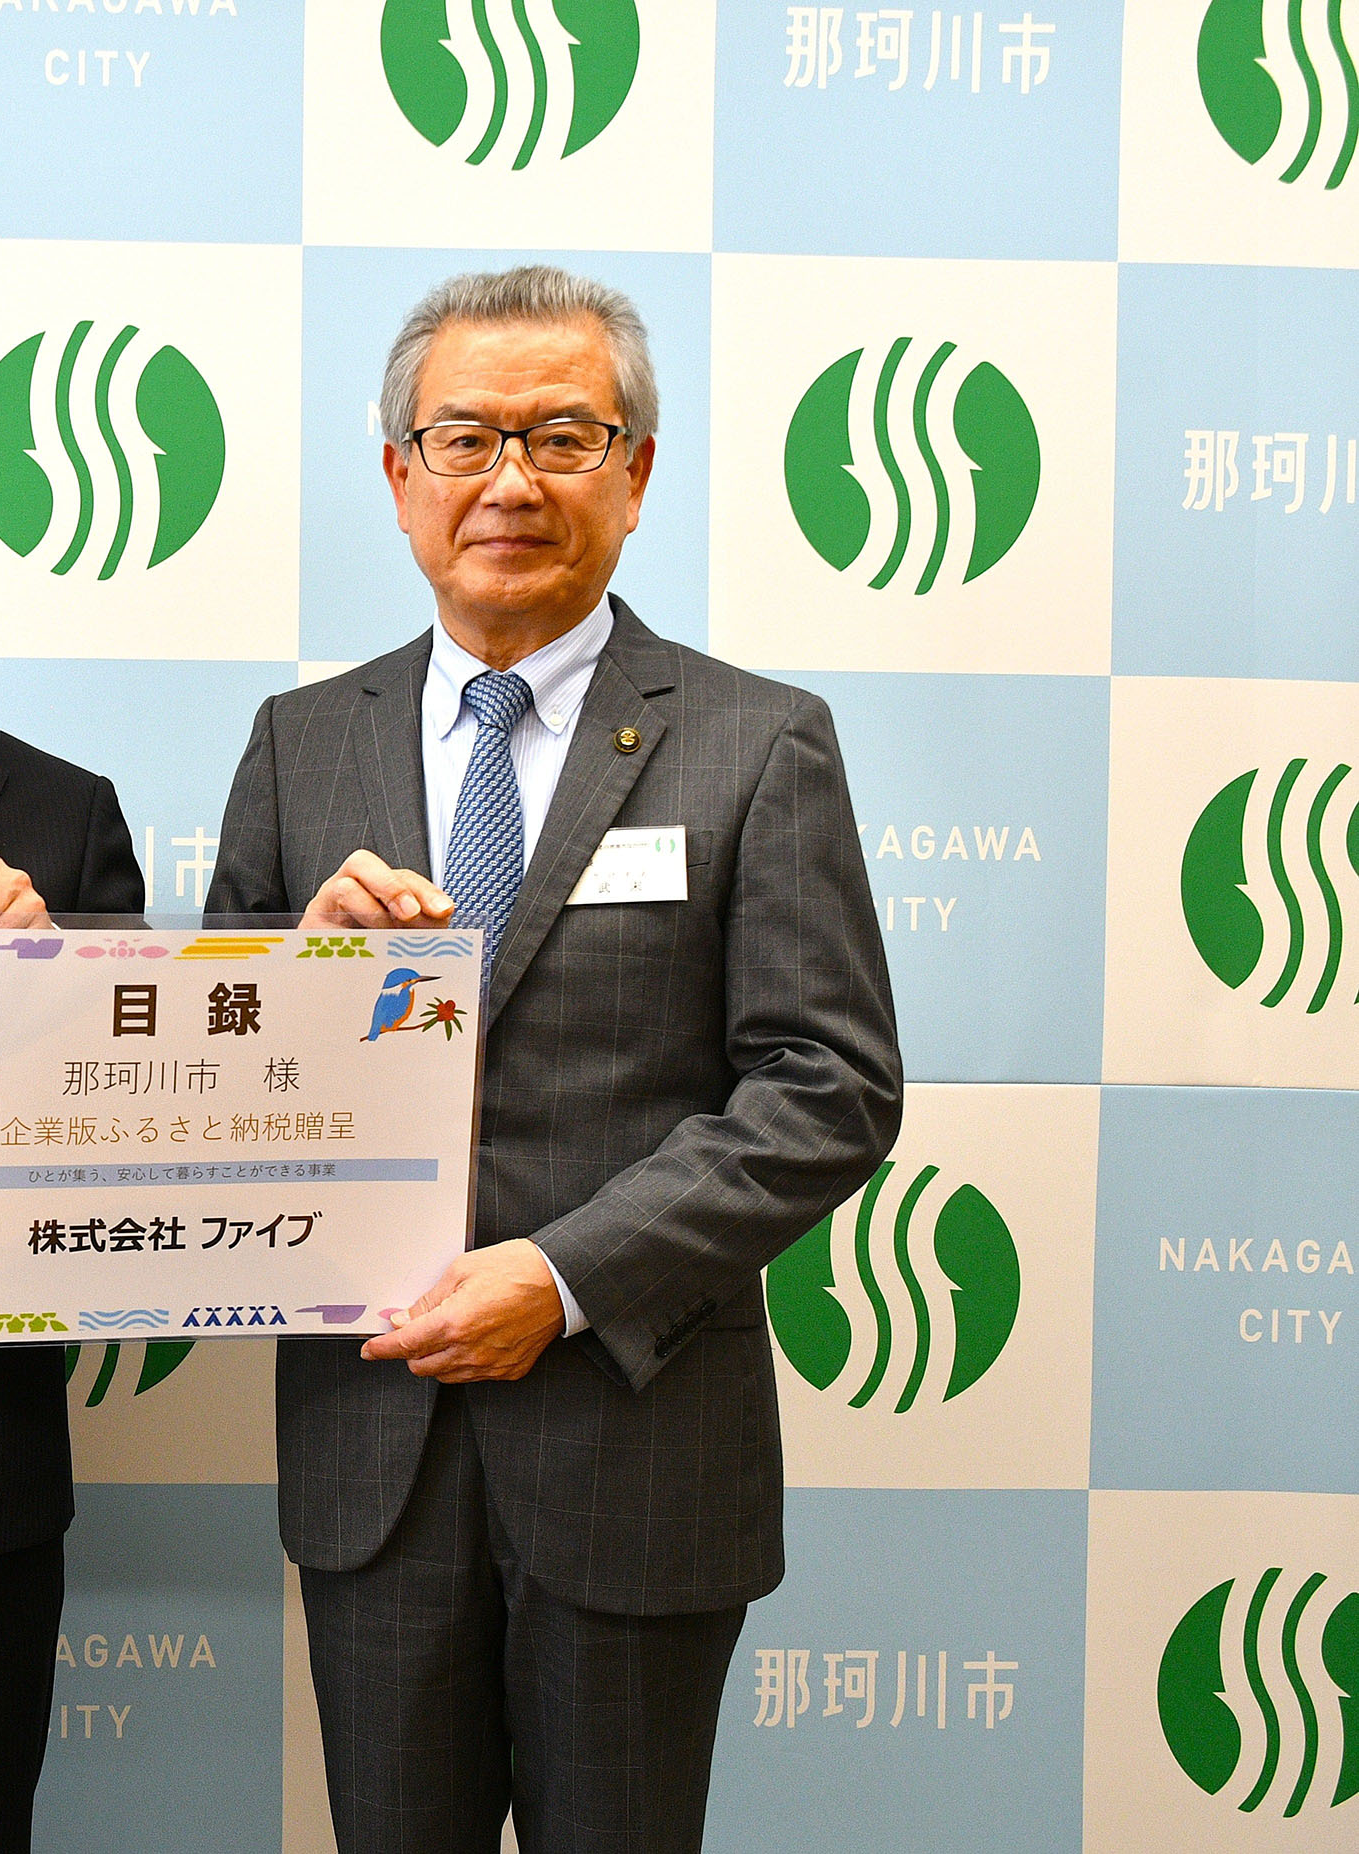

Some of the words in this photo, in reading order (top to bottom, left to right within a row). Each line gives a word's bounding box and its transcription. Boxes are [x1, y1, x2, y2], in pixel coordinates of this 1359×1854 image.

[44, 48, 151, 87] CITY
[784, 6, 1056, 95] 那珂川市
[62, 1059, 221, 1097] 那珂川市
[263, 1056, 300, 1093] 様
[0, 1111, 356, 1146] 企業版ふるさと納税贈呈
[28, 1163, 337, 1183] ひとが集う、安心して暮らすことができる事業
[27, 1216, 186, 1255] 株式会社
[201, 1210, 323, 1250] ファイブ
[1159, 1237, 1354, 1275] NAKAGA
[1239, 1308, 1342, 1345] CITY
[753, 1649, 1020, 1730] 那珂川市
